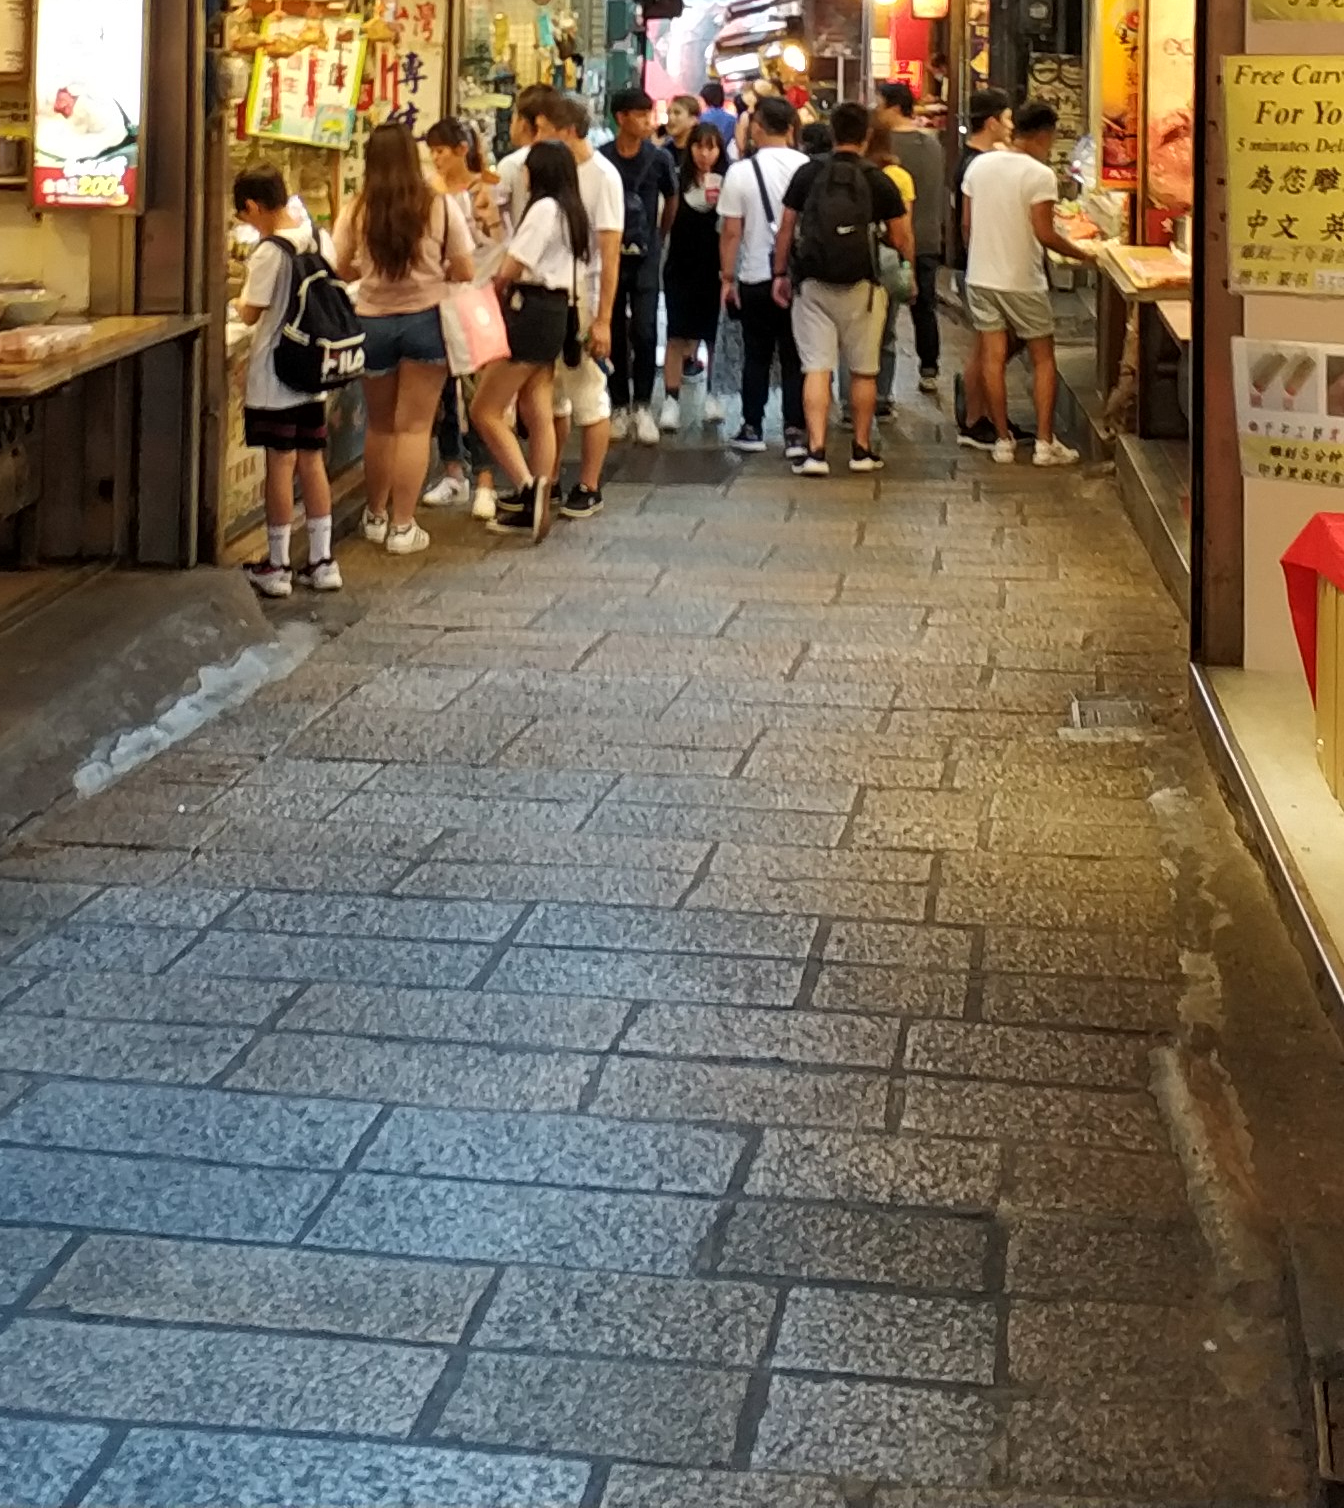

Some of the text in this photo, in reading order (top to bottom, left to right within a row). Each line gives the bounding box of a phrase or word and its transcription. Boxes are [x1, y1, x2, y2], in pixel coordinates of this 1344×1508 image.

[1233, 63, 1286, 86] Free
[1254, 99, 1305, 126] For
[1246, 208, 1300, 240] 中文
[321, 346, 366, 382] FILA
